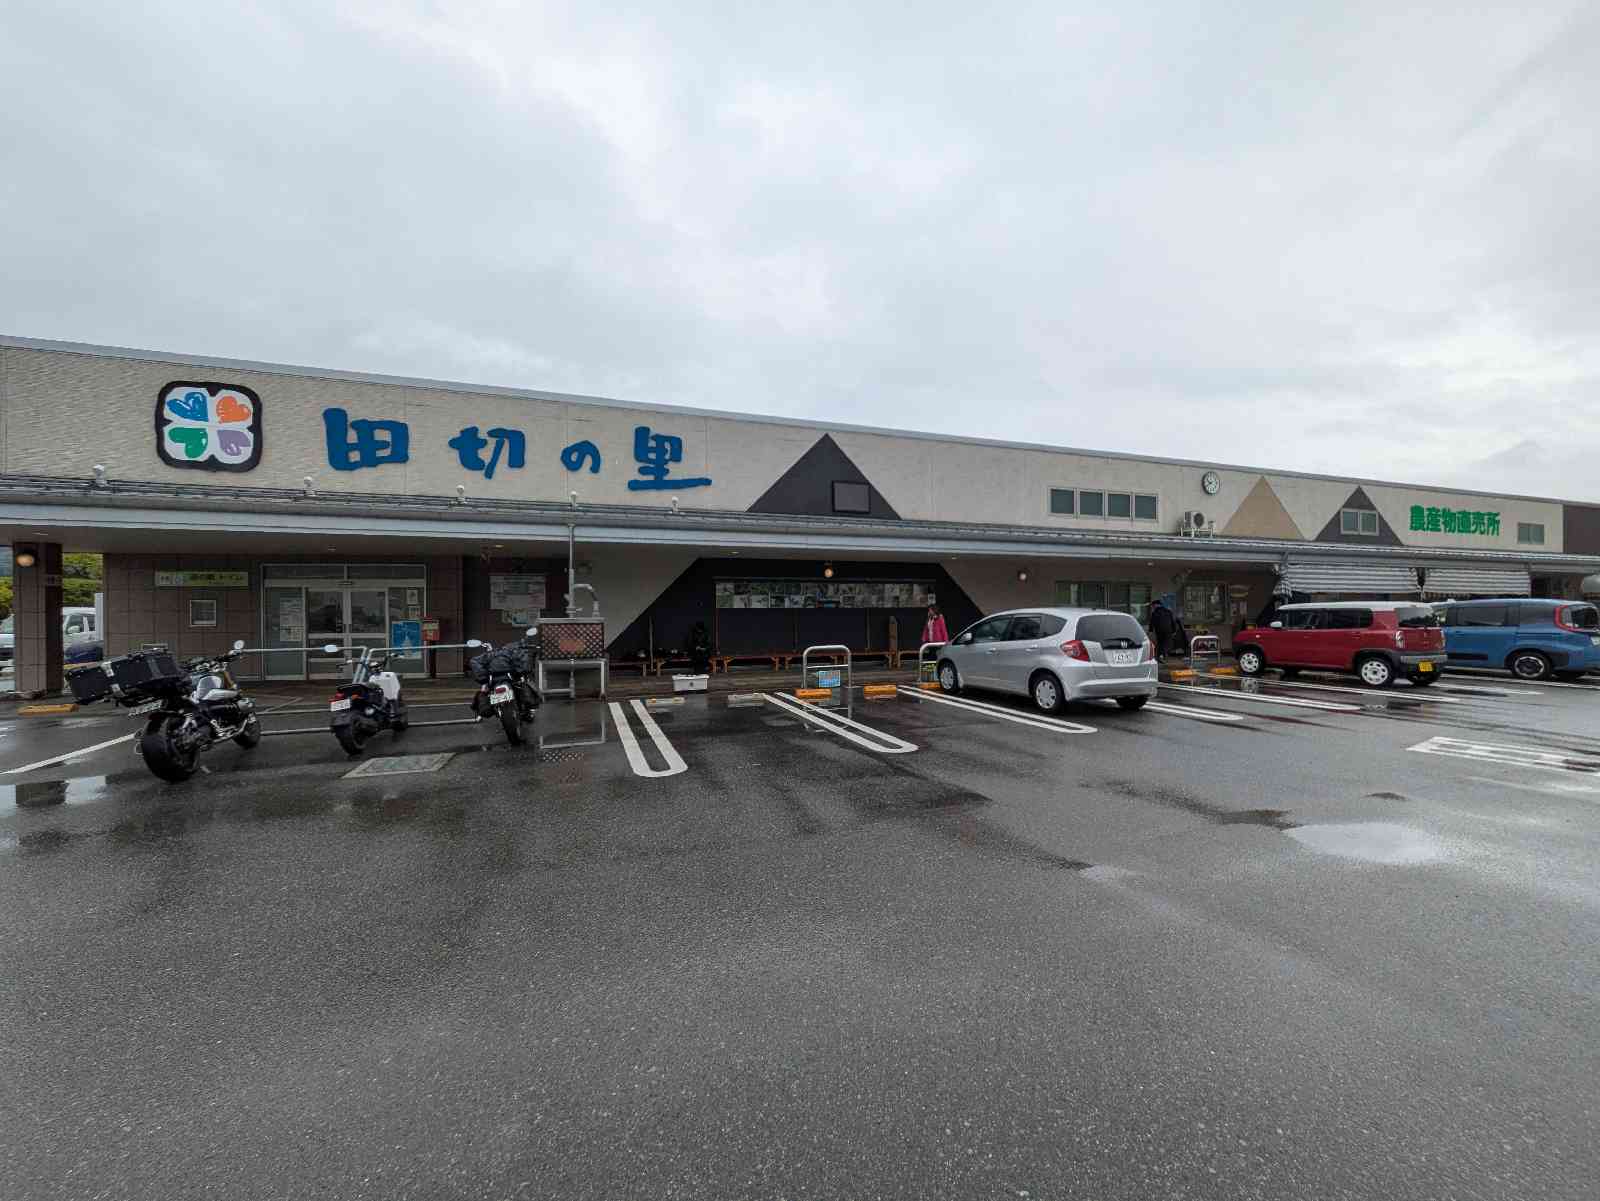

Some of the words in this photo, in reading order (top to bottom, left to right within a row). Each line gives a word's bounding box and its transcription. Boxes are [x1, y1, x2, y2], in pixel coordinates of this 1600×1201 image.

[323, 408, 712, 490] 田切の里
[1409, 505, 1500, 536] 農産物直売所
